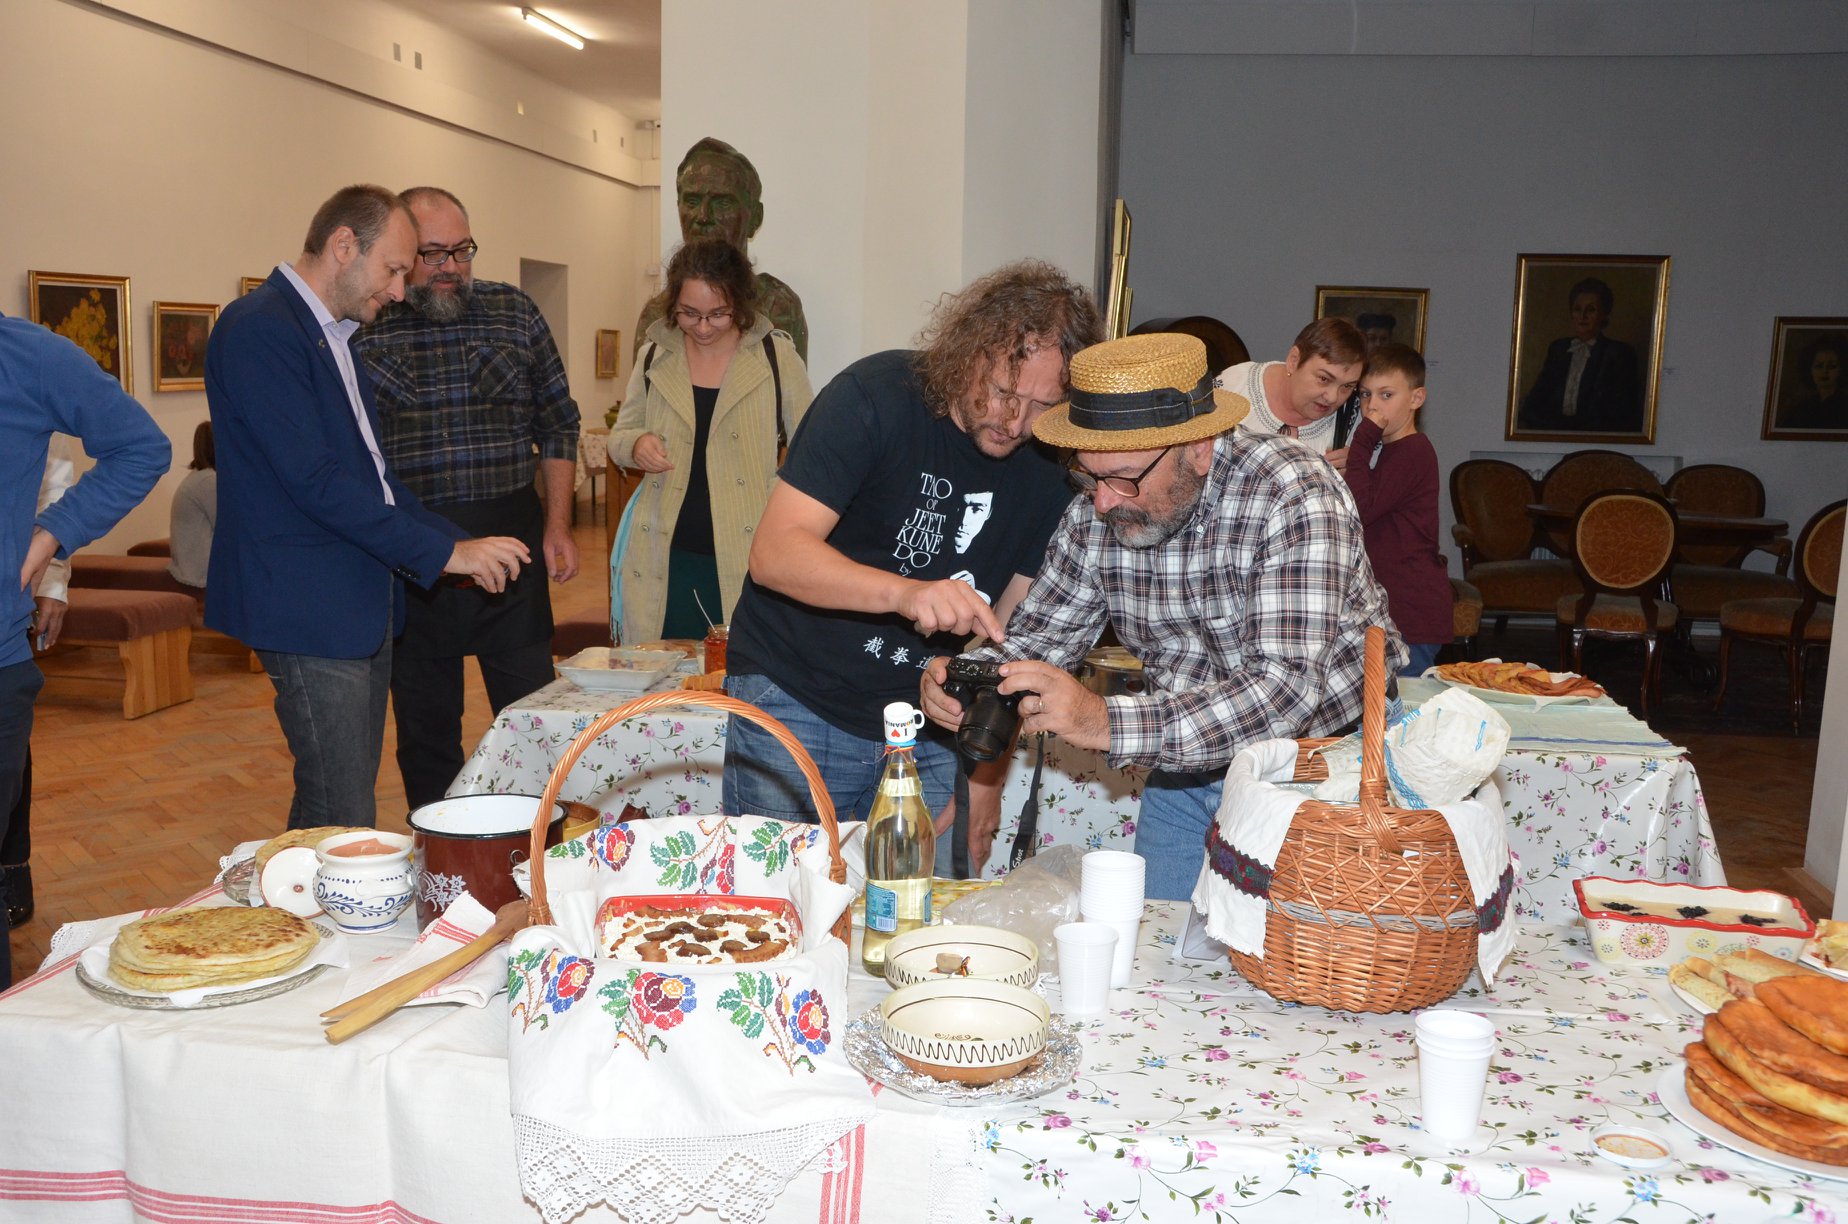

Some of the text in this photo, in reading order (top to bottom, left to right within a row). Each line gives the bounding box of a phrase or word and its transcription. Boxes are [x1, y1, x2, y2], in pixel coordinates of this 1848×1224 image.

[921, 472, 953, 499] TAO
[905, 508, 947, 534] JEET
[895, 525, 944, 555] KUNE
[892, 542, 932, 568] DO
[899, 562, 912, 577] by
